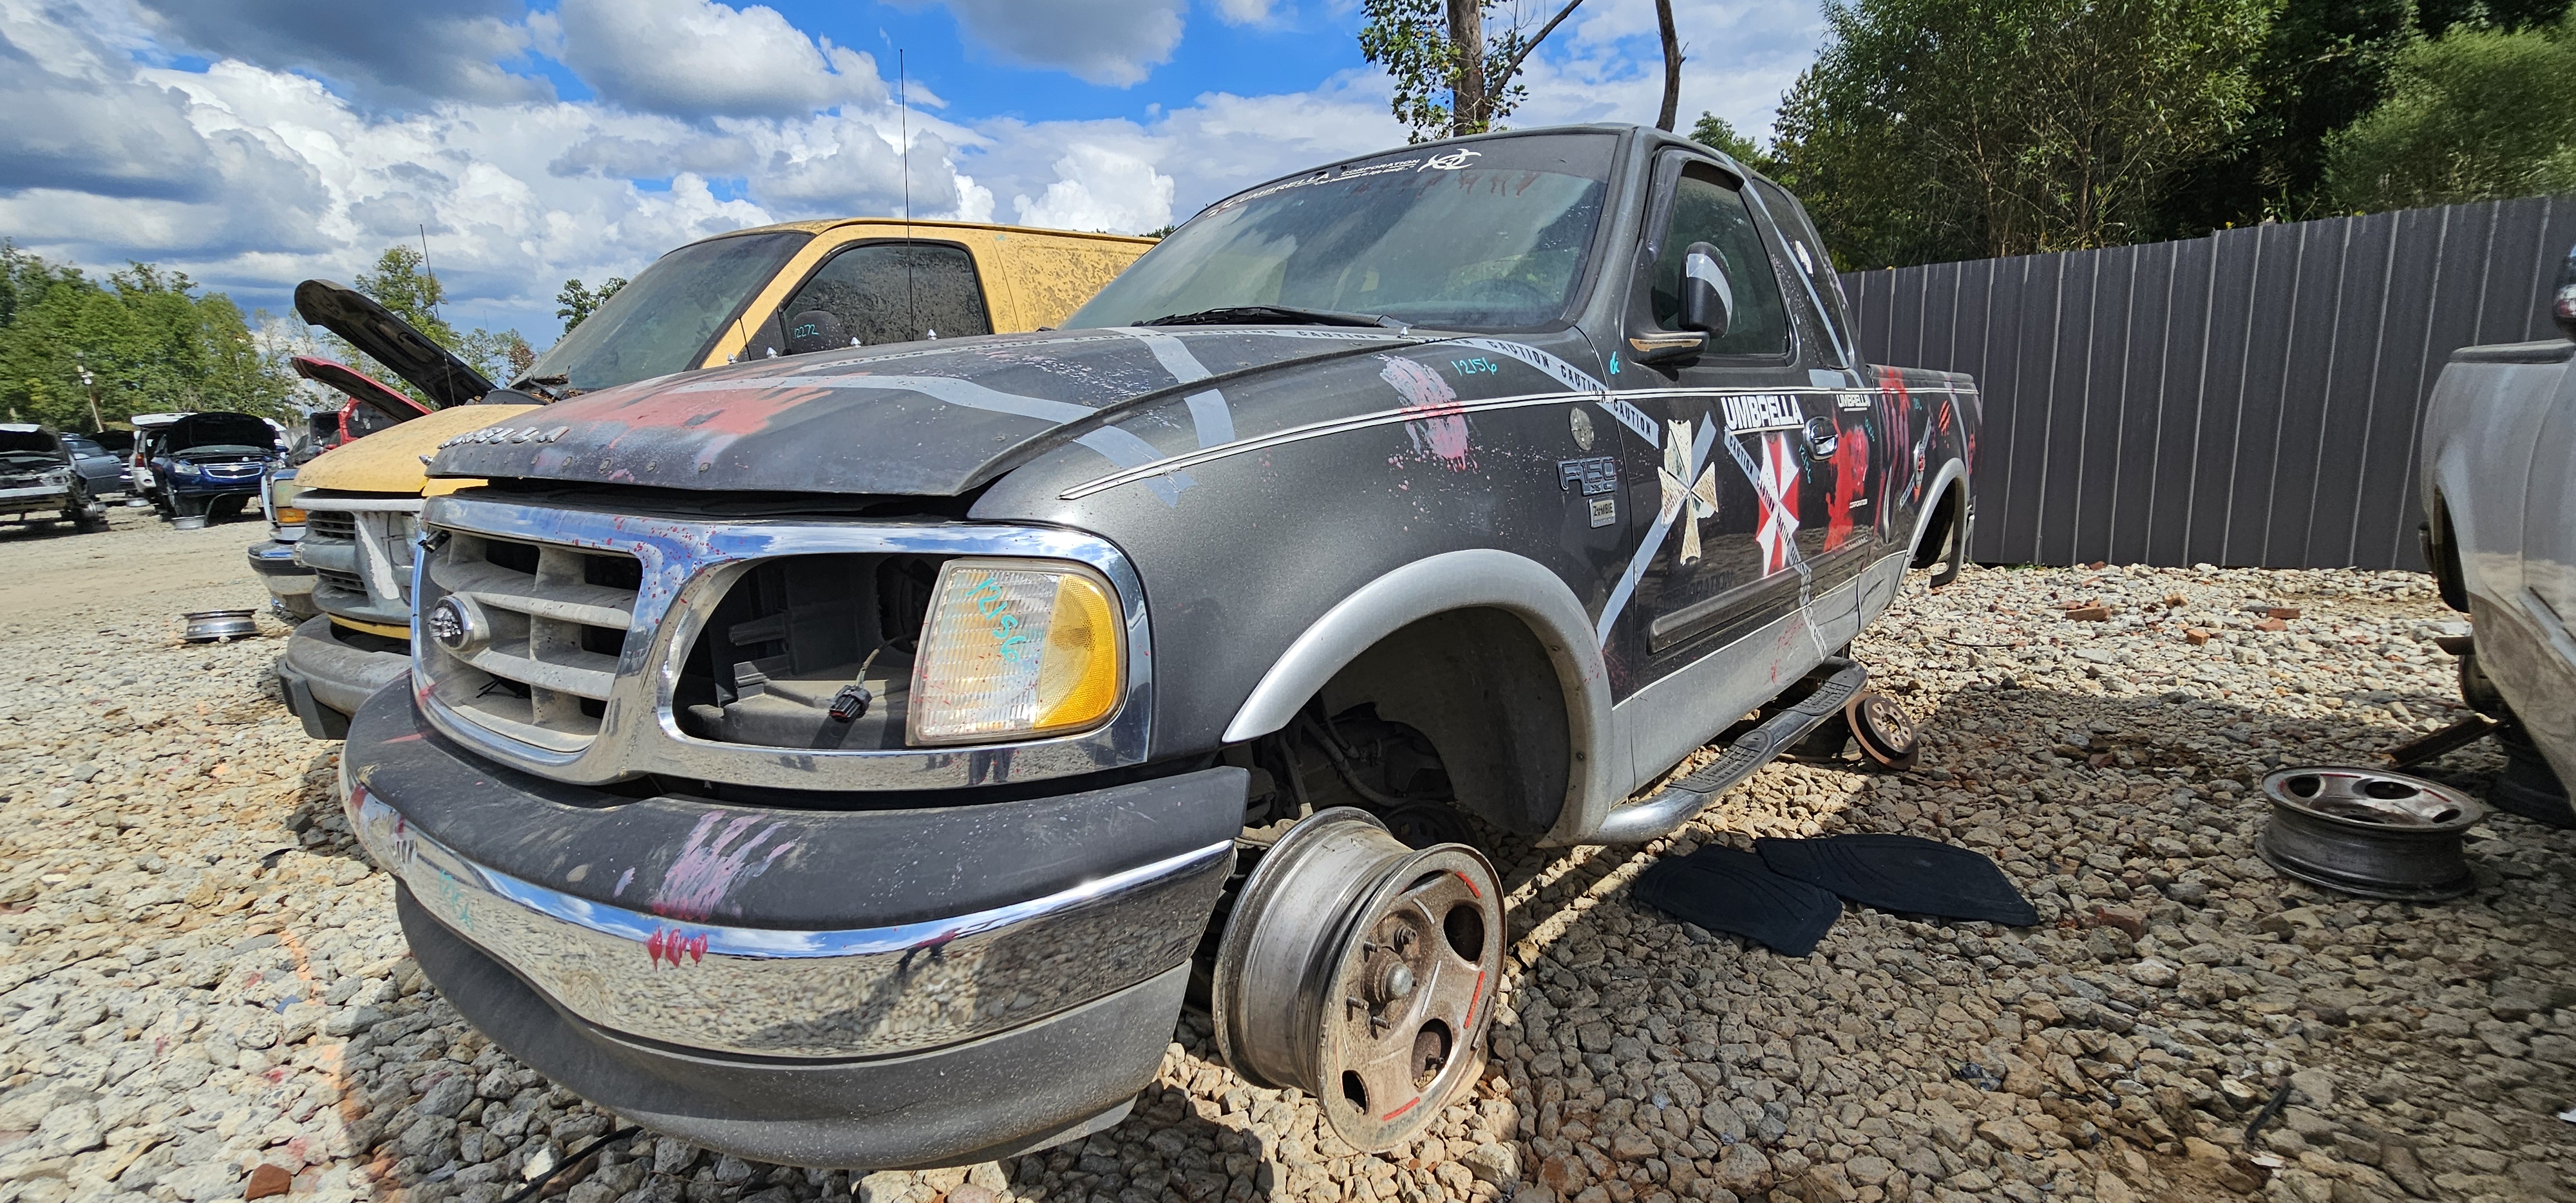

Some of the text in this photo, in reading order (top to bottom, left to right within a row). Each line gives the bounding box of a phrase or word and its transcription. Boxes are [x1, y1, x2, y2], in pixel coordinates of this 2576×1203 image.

[1341, 159, 1421, 175] CORPORATION
[1283, 330, 1379, 339] CAUTION
[1451, 356, 1497, 376] 12156
[1486, 339, 1550, 370] CAUTION
[1613, 397, 1651, 437] CAUTION
[1721, 395, 1804, 430] UMBRELLA
[1836, 394, 1871, 408] UMBRELLA
[1558, 459, 1616, 489] F-150
[1591, 482, 1613, 492] XL
[1729, 435, 1754, 477] CAUTION
[1756, 475, 1775, 514] CAUTION
[1776, 513, 1792, 547] CAUTION
[966, 577, 1027, 663] 12156
